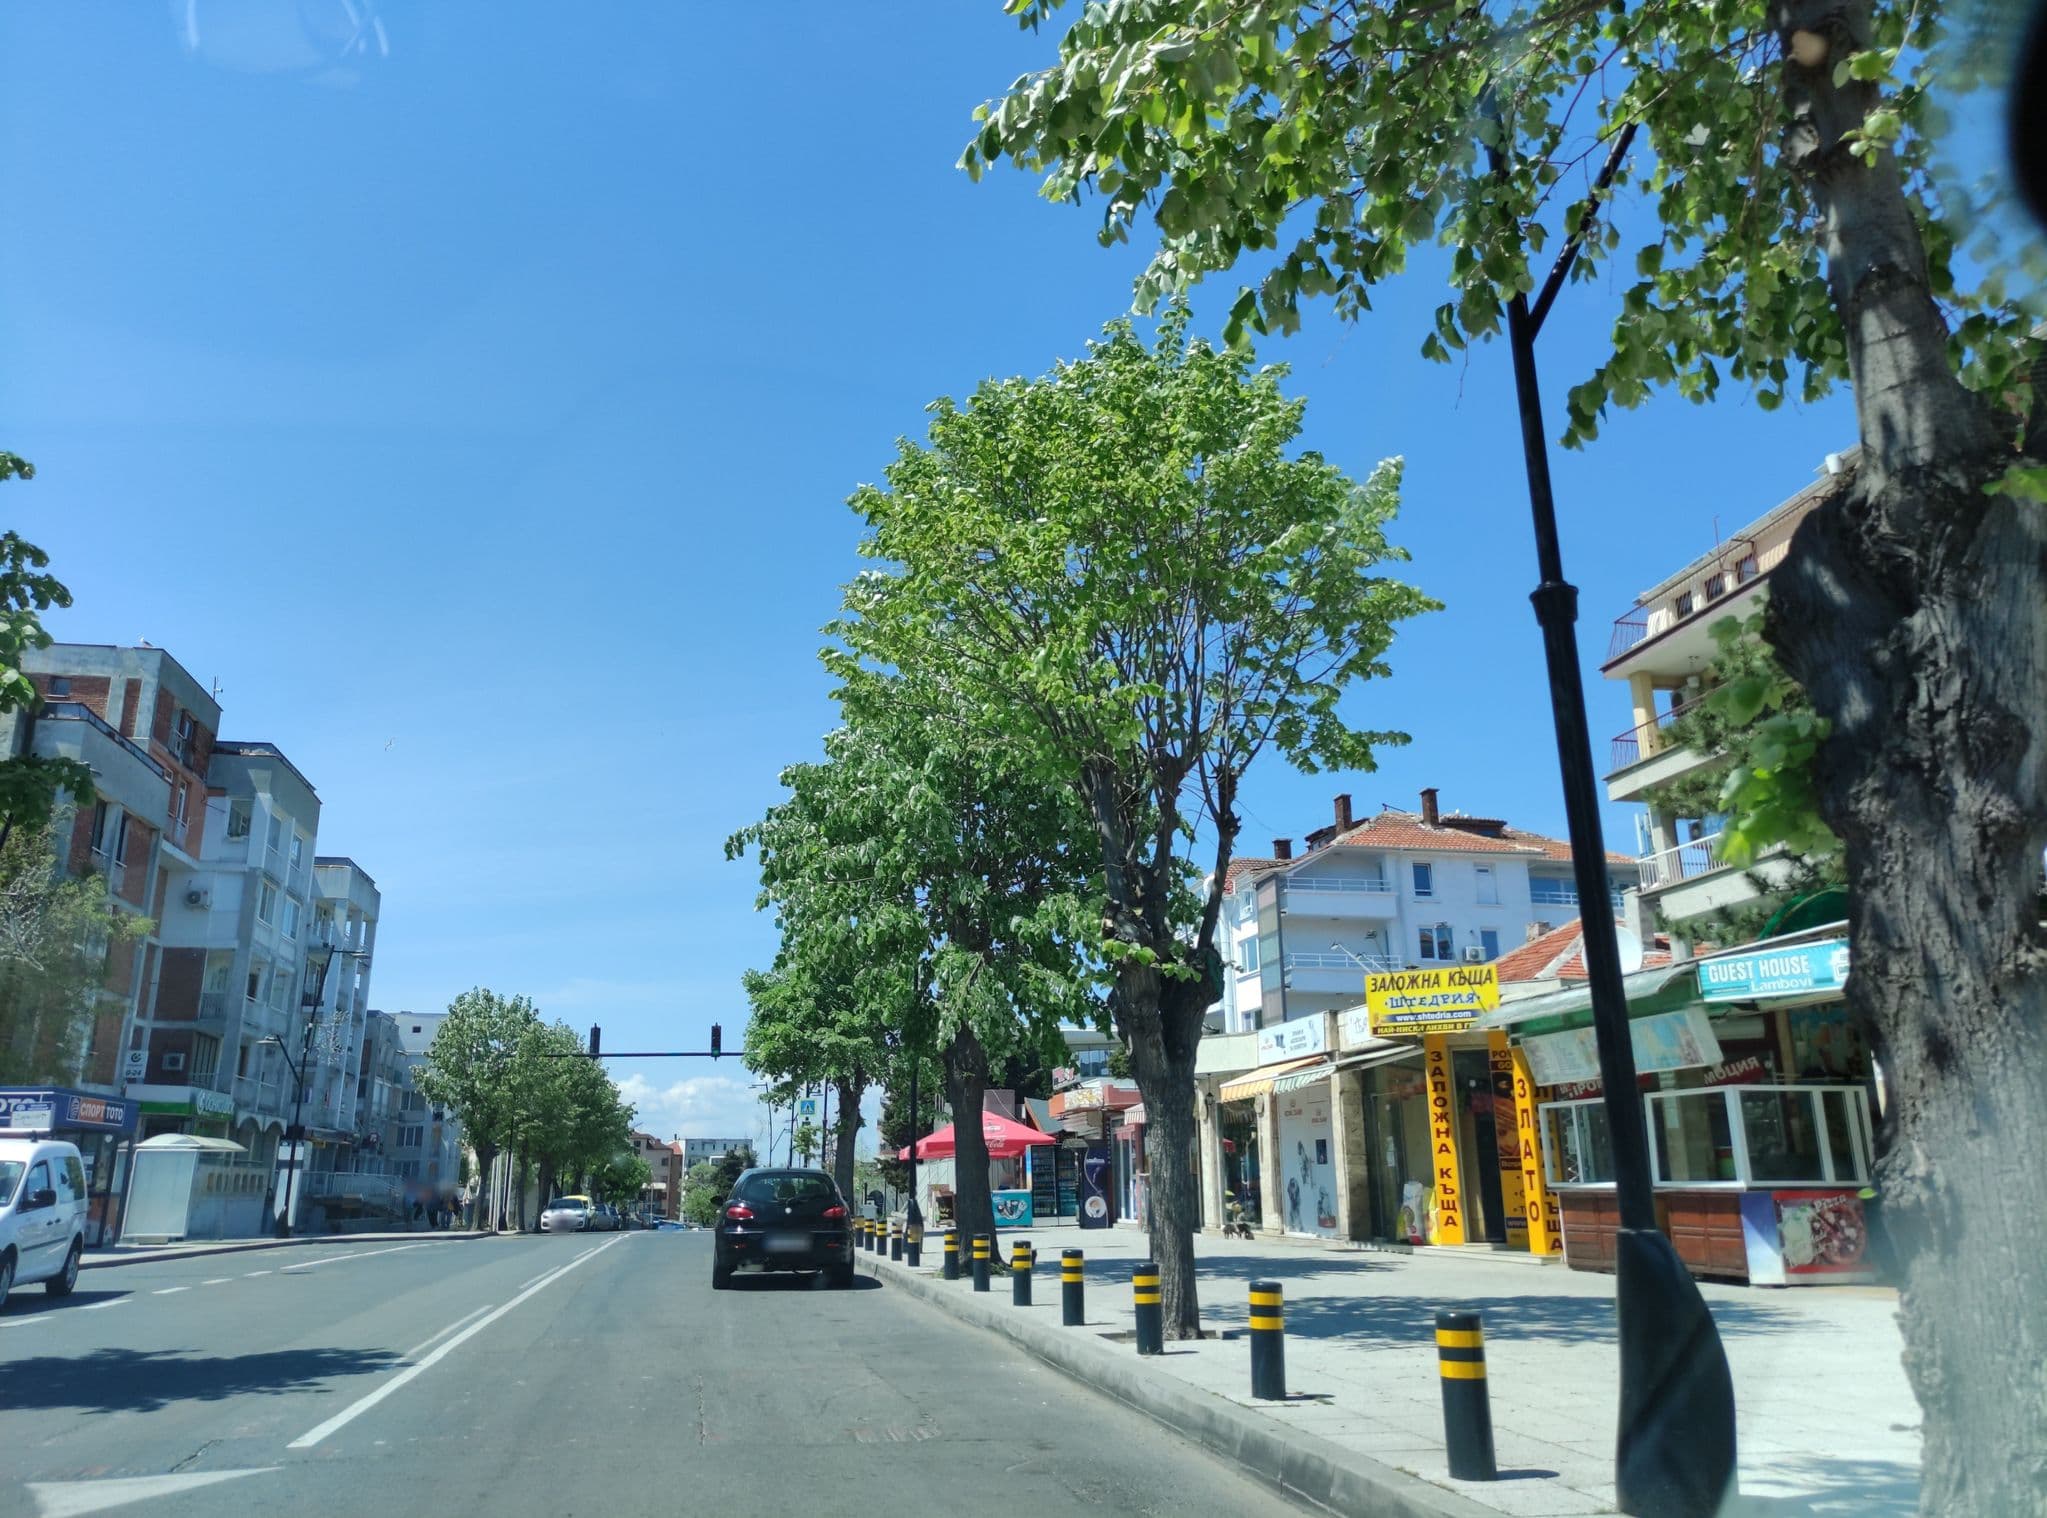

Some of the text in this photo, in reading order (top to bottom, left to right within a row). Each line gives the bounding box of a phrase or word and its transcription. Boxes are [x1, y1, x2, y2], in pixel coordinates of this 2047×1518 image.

[1709, 954, 1811, 983] GUEST HOUSE
[1370, 968, 1493, 993] ЗАЛОЖНА КЪЩА
[1750, 977, 1813, 992] Lambovi
[1389, 992, 1476, 1009] ШТЕДРИЯ
[1395, 1010, 1472, 1022] www.shtedria.com
[80, 1102, 105, 1119] СПОРТ
[106, 1106, 123, 1121] ТОТО
[1430, 1050, 1459, 1227] ЗАЛОЖНА КЪЩА
[1516, 1078, 1540, 1222] ЗЛАТО
